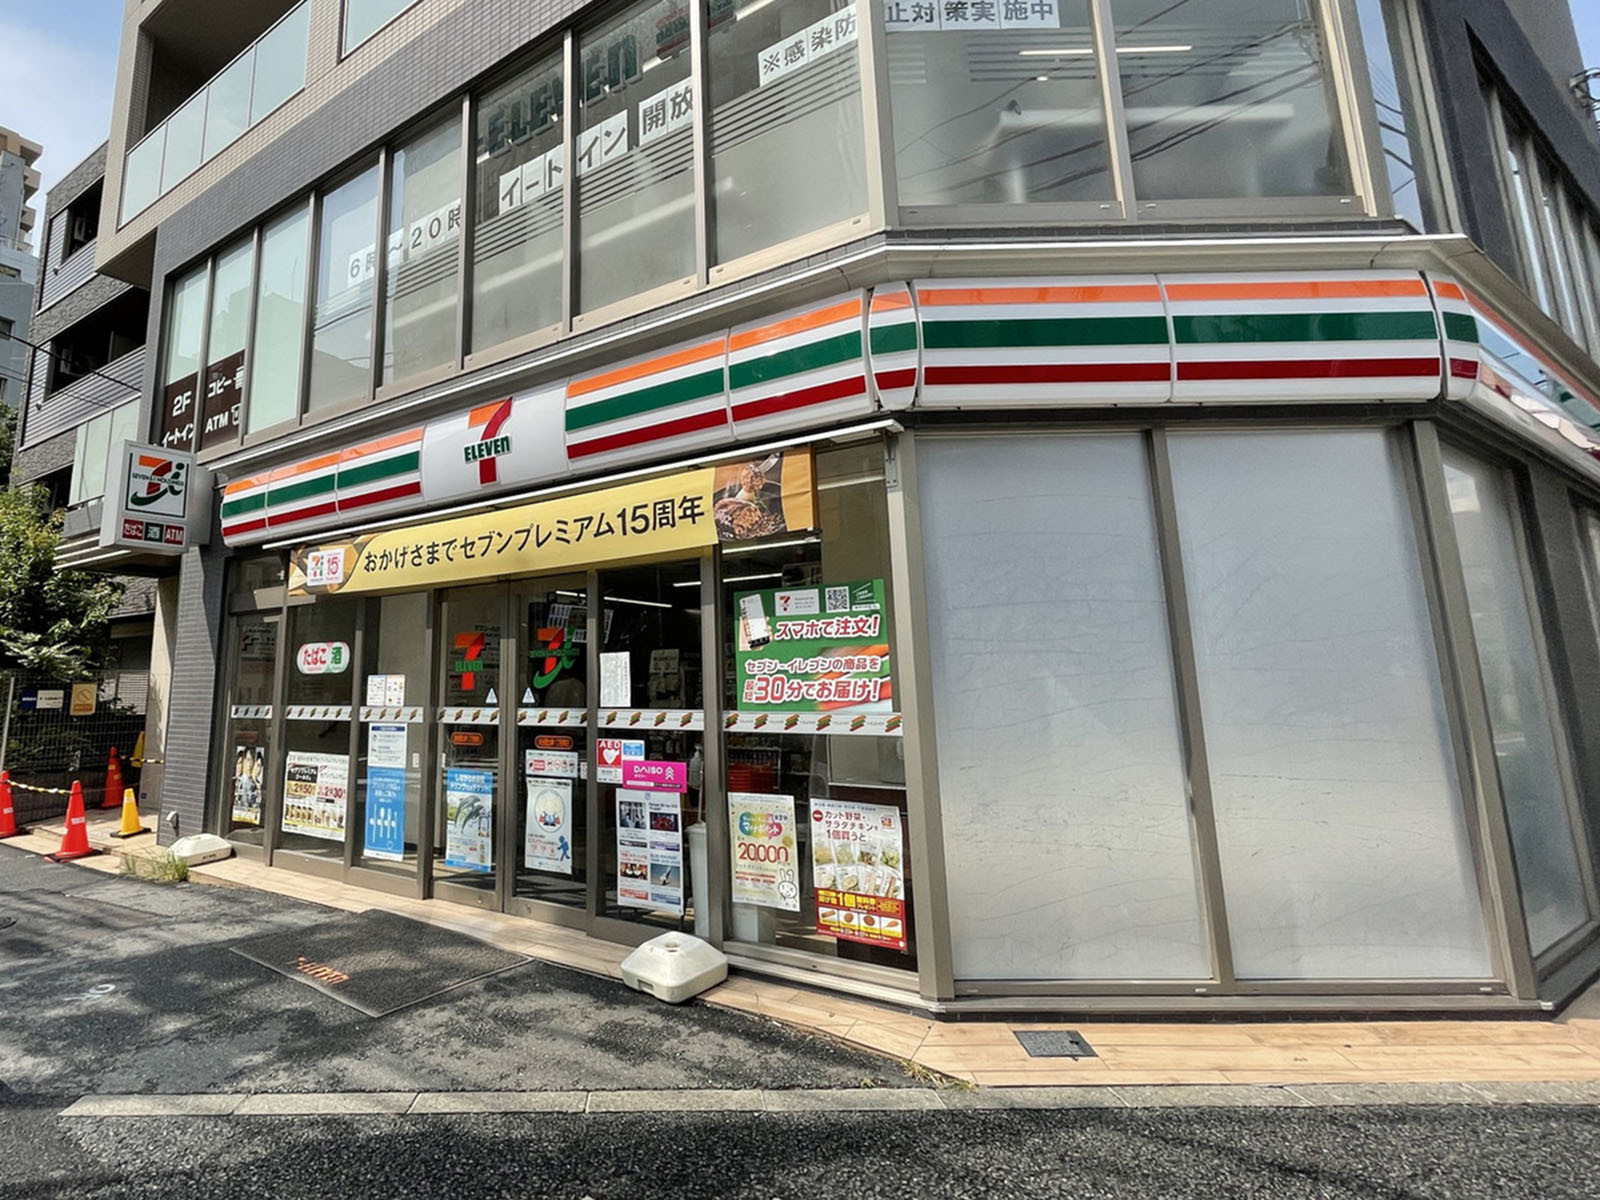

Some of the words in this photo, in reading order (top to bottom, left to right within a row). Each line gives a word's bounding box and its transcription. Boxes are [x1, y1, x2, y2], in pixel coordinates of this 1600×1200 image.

[886, 0, 1054, 24] 止対策実施中
[173, 391, 192, 416] 2F
[205, 411, 229, 434] ATM
[165, 528, 184, 542] ATM
[363, 495, 705, 573] おかげさまでセブンプレミアム15周年
[776, 616, 879, 639] スマホで注文!
[331, 646, 343, 665] 酒
[599, 740, 621, 749] AED
[633, 765, 664, 775] DAISO
